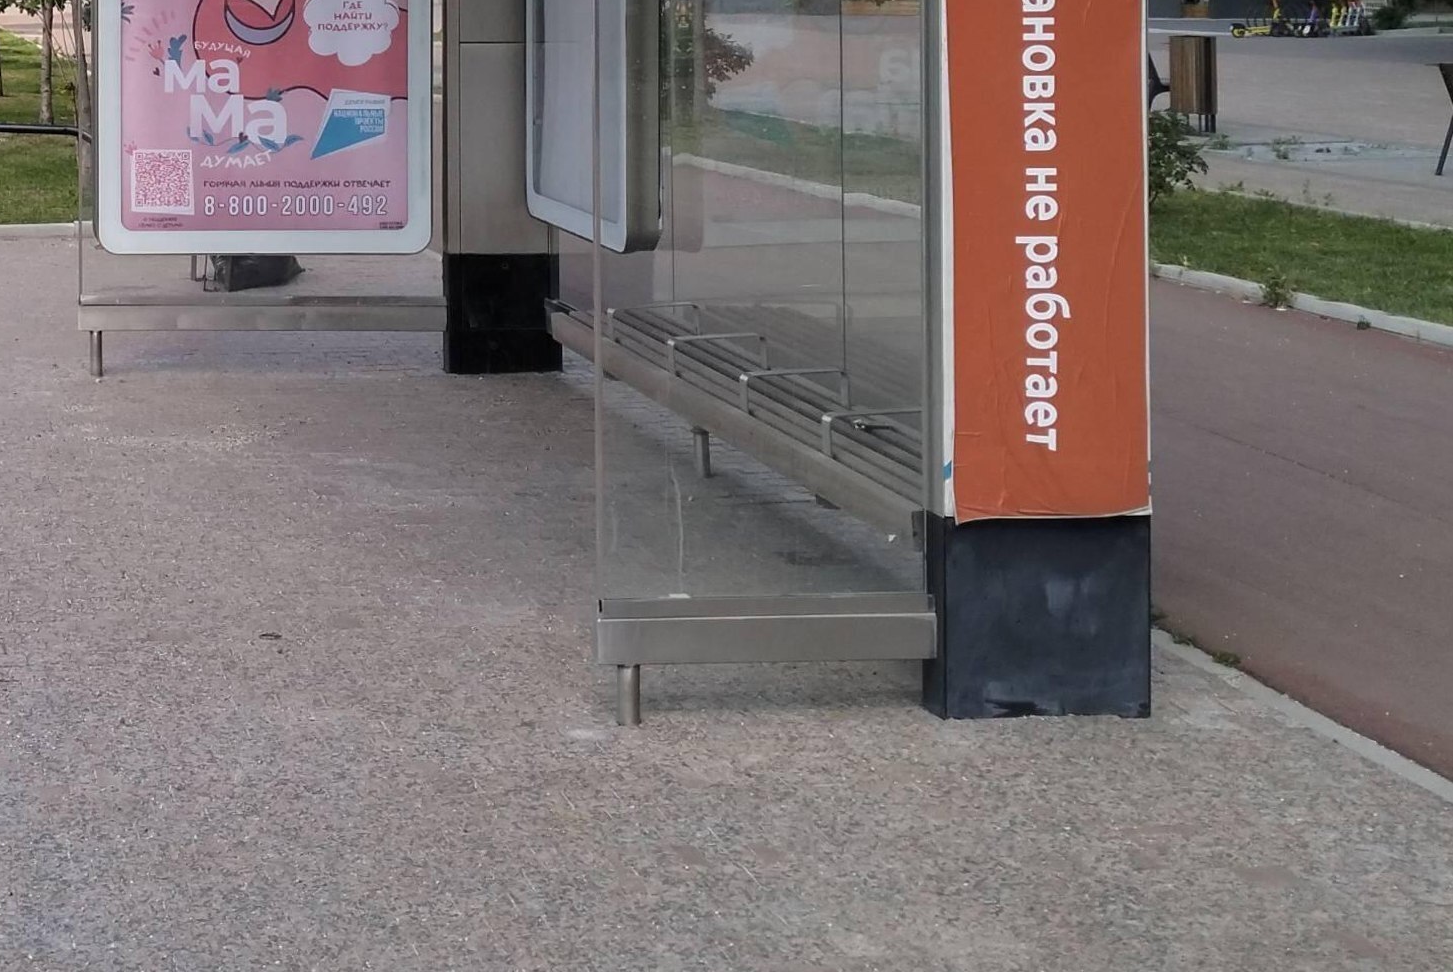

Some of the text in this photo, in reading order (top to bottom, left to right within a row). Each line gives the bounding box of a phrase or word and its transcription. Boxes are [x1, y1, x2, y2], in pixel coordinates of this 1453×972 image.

[342, 0, 363, 10] ГДЕ
[334, 12, 372, 20] НАЙТИ
[317, 22, 388, 32] ПОДДЕРЖКУ?
[200, 149, 273, 168] ДУМАЕТ
[203, 179, 391, 189] ГОРЯЧАЯ ЛИНИЯ ПОДДЕРЖКИ ОТВЕЧАЕТ
[1025, 167, 1058, 221] не
[203, 195, 388, 216] 8-800-2000-492
[1015, 235, 1070, 451] работает
